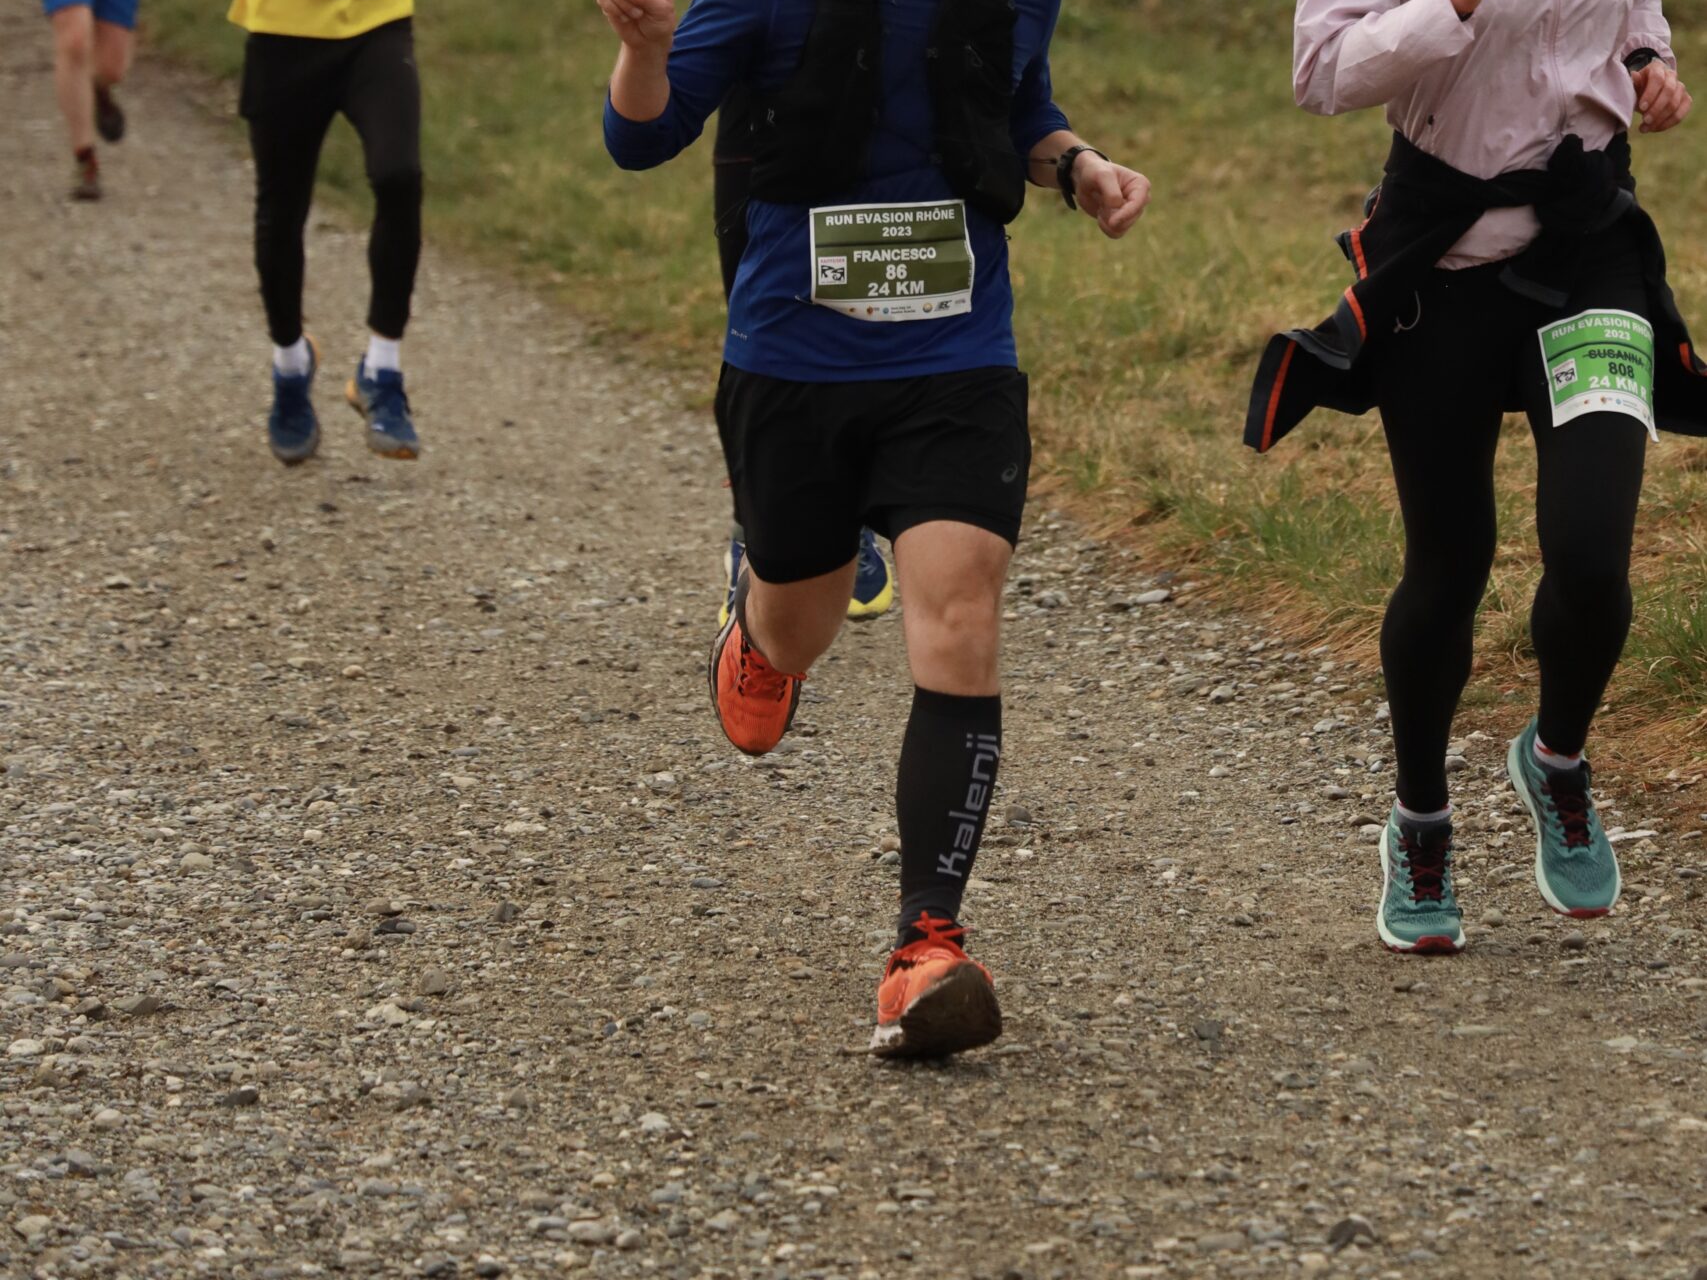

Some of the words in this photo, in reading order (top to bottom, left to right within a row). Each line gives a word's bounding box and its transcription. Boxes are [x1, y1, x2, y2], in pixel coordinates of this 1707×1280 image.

[826, 213, 853, 226] RUN
[856, 212, 913, 224] EVASION
[916, 207, 955, 221] RHÔNE
[882, 226, 912, 237] 2023
[853, 247, 937, 263] FRANCESCO
[885, 264, 908, 280] 86
[867, 282, 890, 297] 24
[896, 280, 925, 296] KM
[1551, 323, 1576, 340] RUN
[1578, 317, 1631, 329] EVASION
[1604, 328, 1631, 340] 2023
[1608, 361, 1635, 379] 808
[1588, 375, 1611, 389] 24
[1615, 376, 1638, 395] KM
[936, 732, 1000, 878] kalenji
